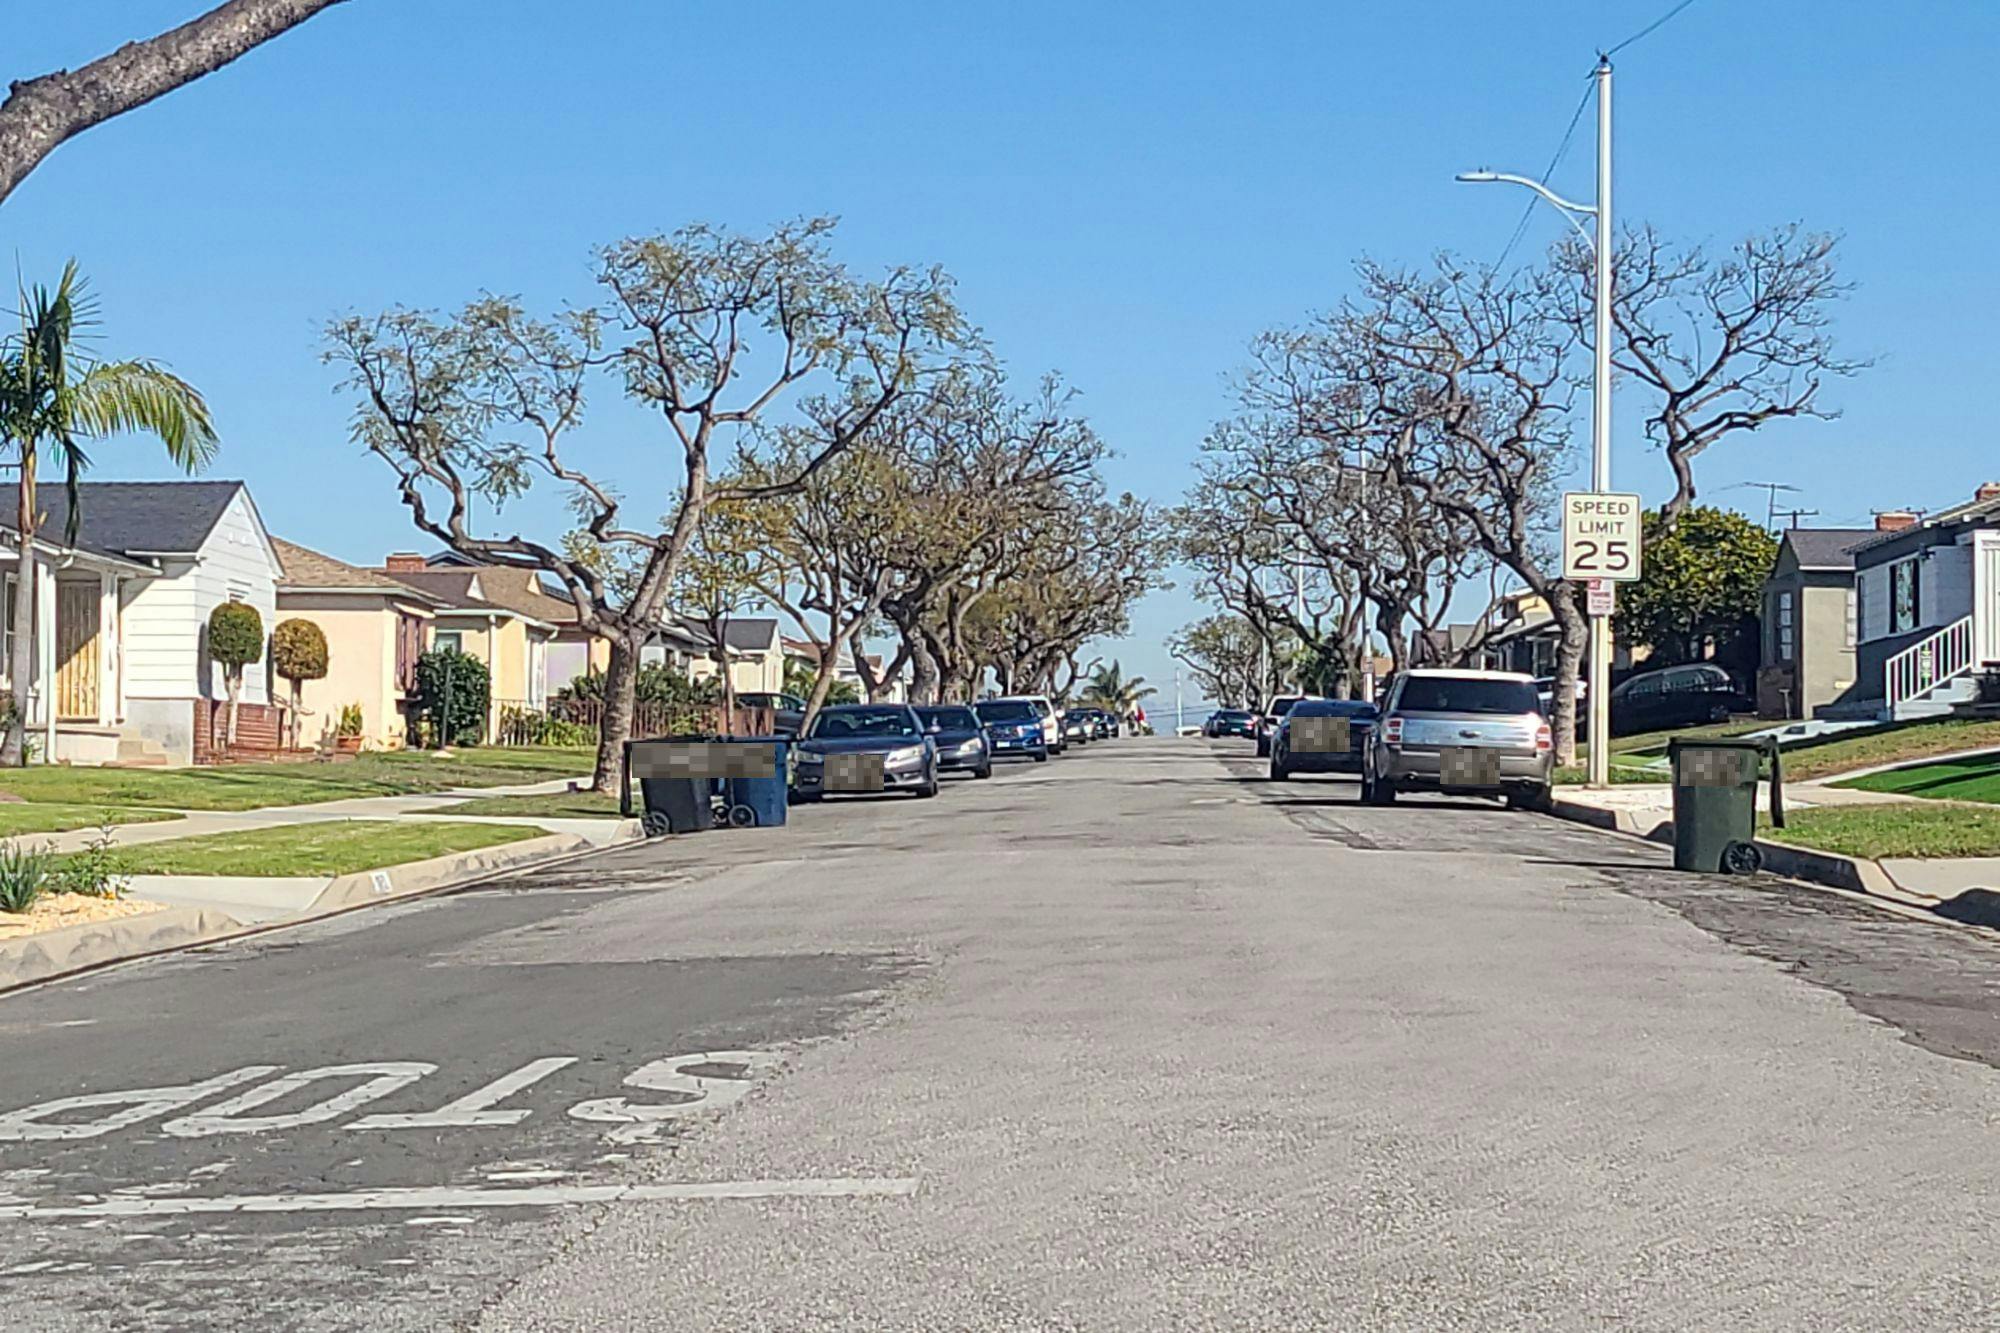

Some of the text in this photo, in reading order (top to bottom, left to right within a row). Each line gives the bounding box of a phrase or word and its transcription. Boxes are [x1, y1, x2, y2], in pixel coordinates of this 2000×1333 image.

[1571, 501, 1630, 515] SPEED
[1579, 521, 1624, 534] LIMIT
[1572, 541, 1630, 571] 25
[0, 1050, 772, 1138] STOP
